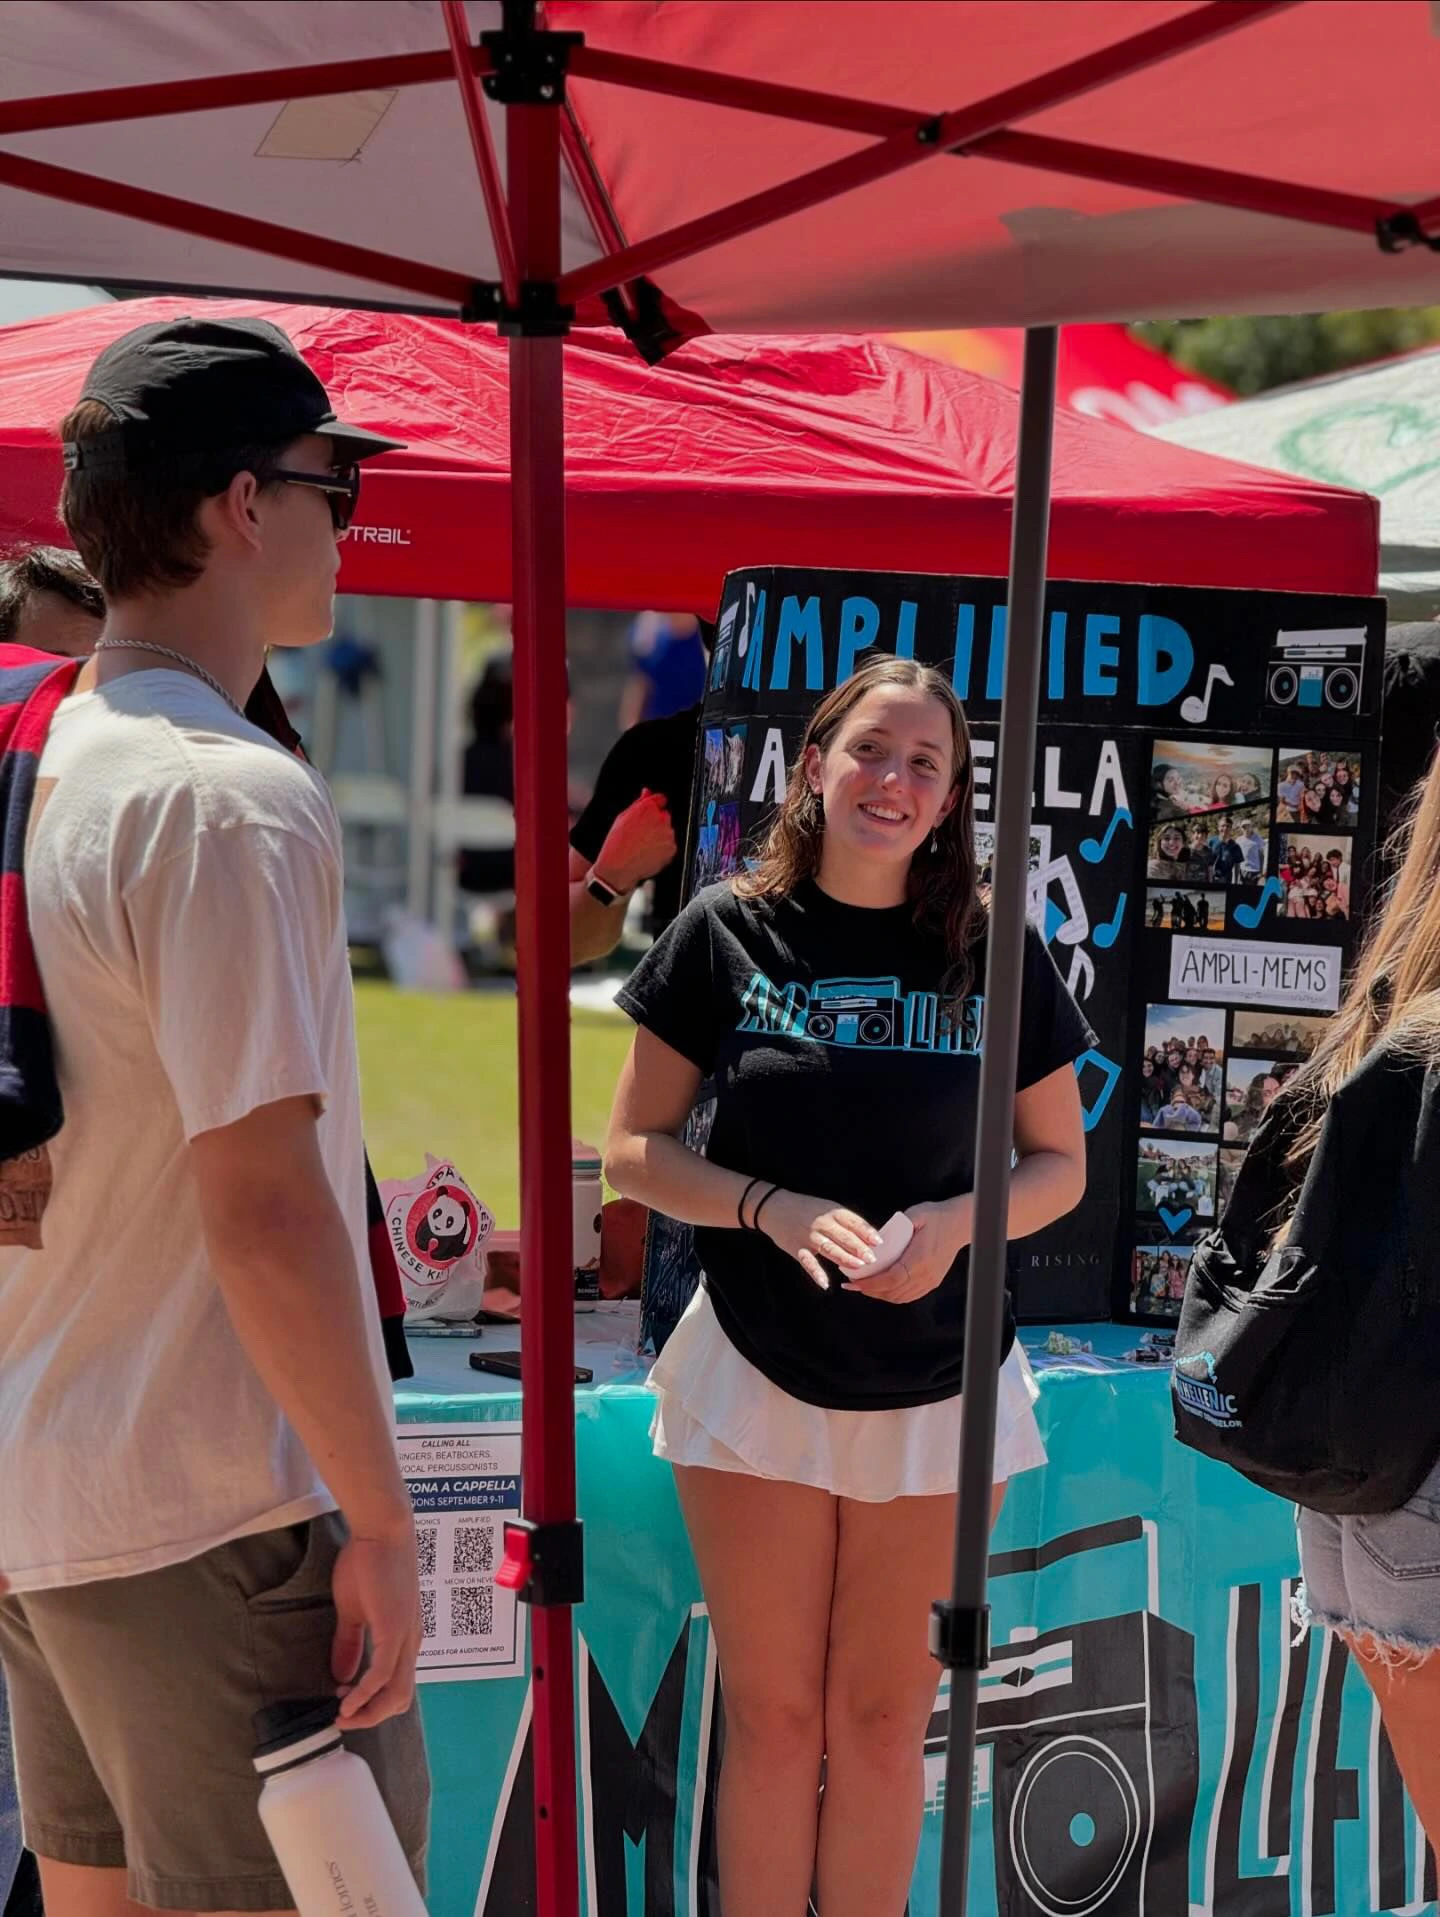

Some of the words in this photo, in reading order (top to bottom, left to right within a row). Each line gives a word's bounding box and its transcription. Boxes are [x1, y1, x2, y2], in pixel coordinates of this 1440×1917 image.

[1181, 950, 1327, 992] AMPLI-MEMS
[391, 1217, 424, 1273] CHINESE
[1031, 1254, 1099, 1268] RISING
[421, 1440, 454, 1448] CALLING
[456, 1439, 471, 1447] ALL
[427, 1462, 498, 1472] PERCUSSIONISTS
[406, 1482, 438, 1494] ZONA
[441, 1481, 450, 1492] A
[453, 1480, 516, 1492] CAPPELLA
[437, 1496, 488, 1506] SEPTEMBER
[489, 1495, 504, 1504] 9-11
[458, 1516, 491, 1524] AMPLIFIED
[476, 1576, 496, 1584] NEVE
